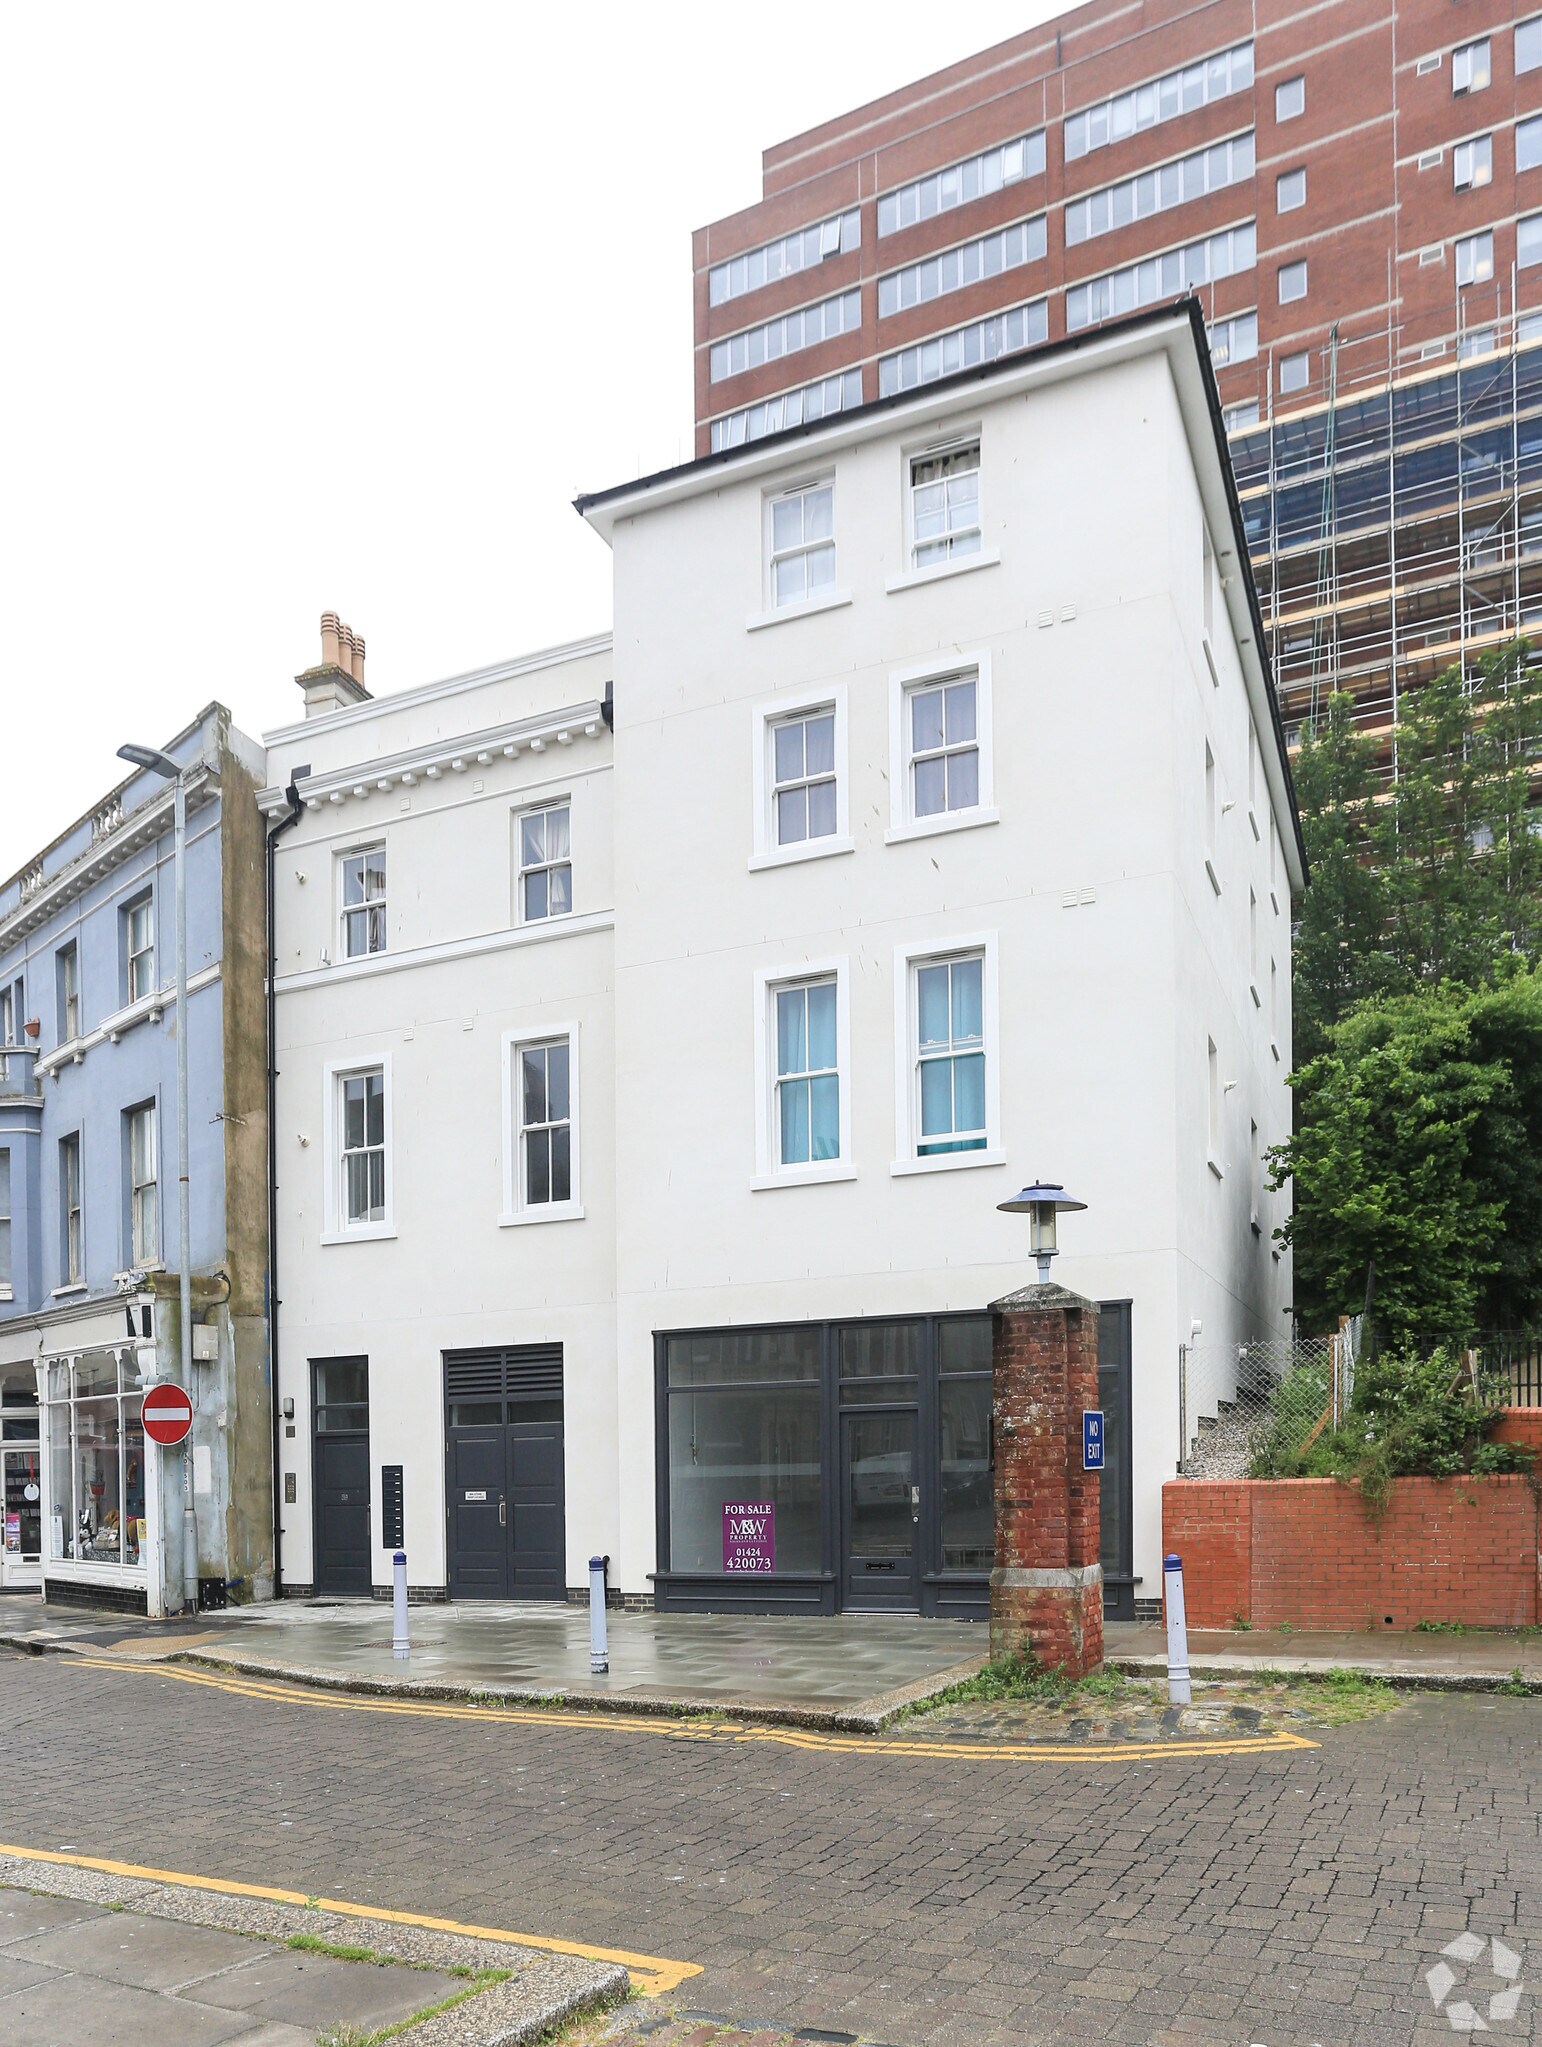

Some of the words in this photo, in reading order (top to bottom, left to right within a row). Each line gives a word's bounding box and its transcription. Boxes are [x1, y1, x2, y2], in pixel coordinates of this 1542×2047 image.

[1089, 1420, 1099, 1437] NO
[1088, 1443, 1100, 1459] EXIT
[724, 1505, 746, 1515] FOR
[747, 1504, 772, 1514] SALE
[729, 1519, 767, 1535] M&W
[736, 1547, 761, 1557] 01424
[726, 1557, 771, 1570] 420073
